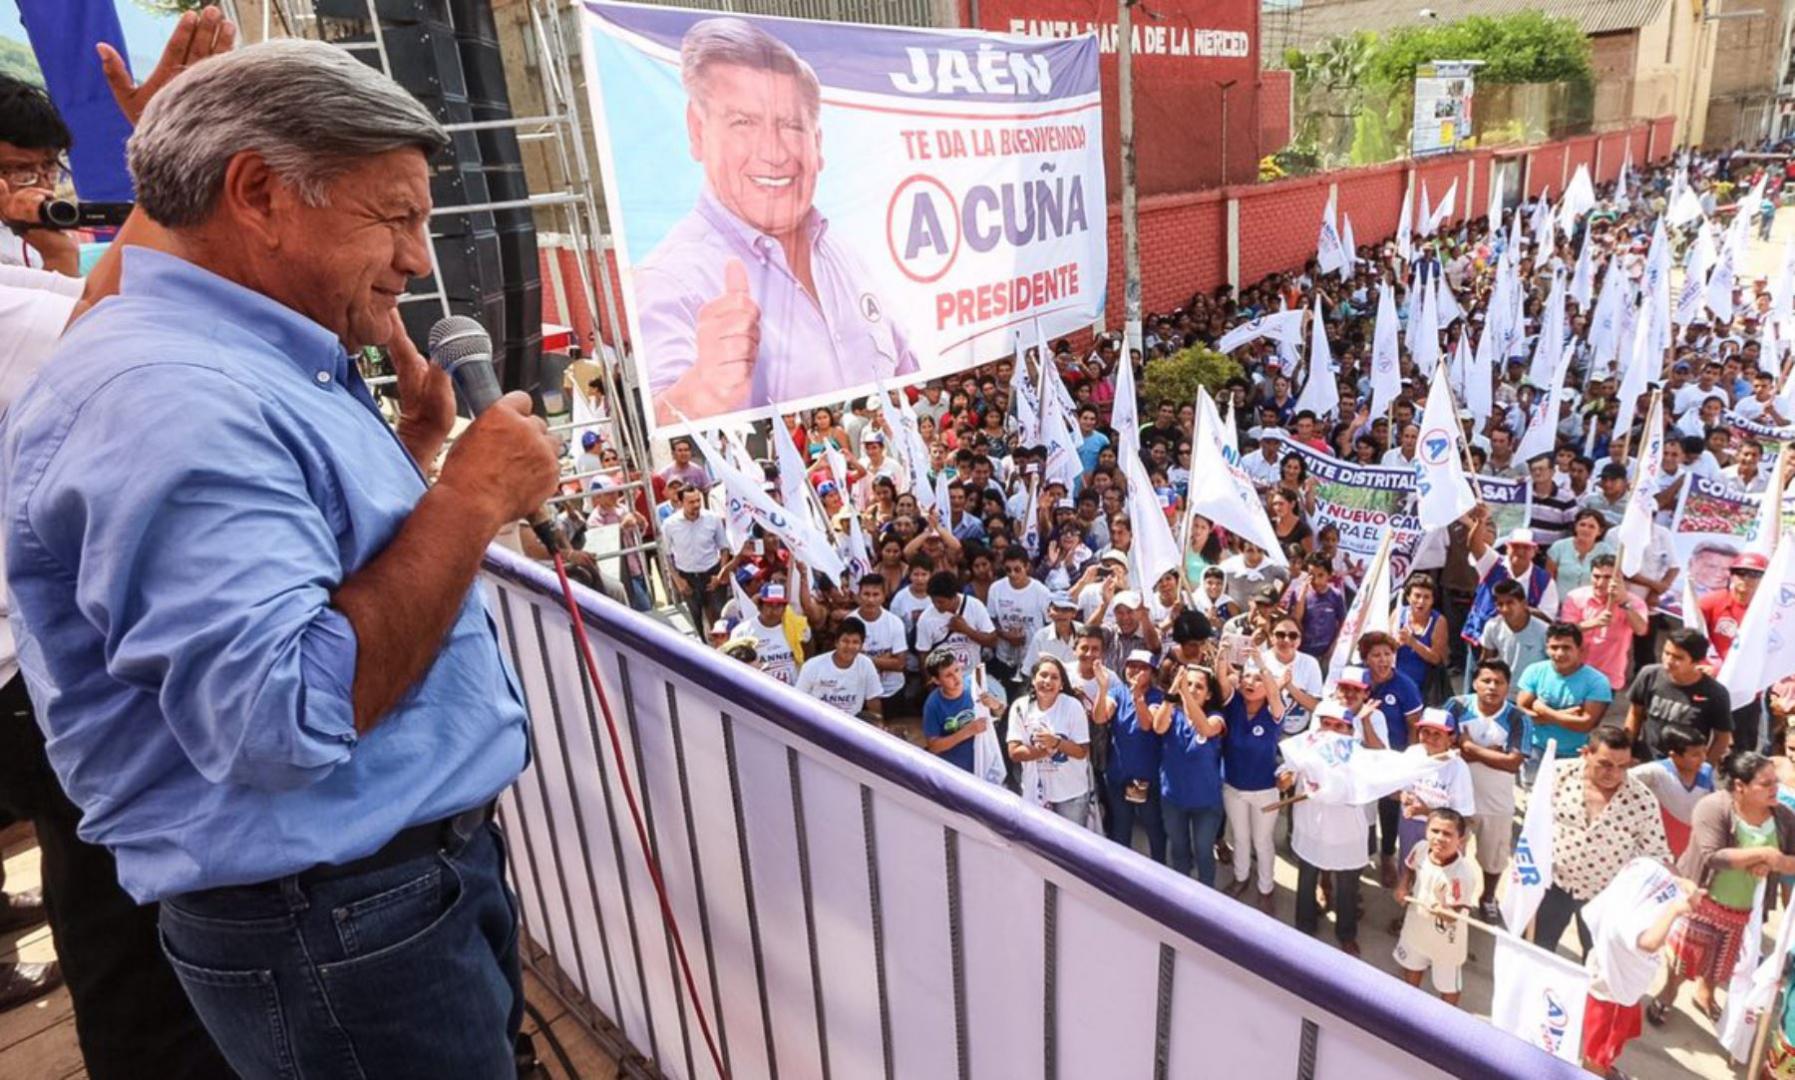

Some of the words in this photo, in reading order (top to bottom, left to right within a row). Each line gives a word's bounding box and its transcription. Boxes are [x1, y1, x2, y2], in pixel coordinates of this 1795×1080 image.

[1145, 26, 1166, 54] DE
[1170, 27, 1190, 56] LA
[1194, 29, 1249, 57] MERCED
[888, 43, 1052, 95] JAÉN
[900, 130, 931, 160] TE
[936, 130, 967, 158] DA
[971, 129, 996, 156] LA
[904, 162, 1088, 260] ACUÑA
[935, 262, 1079, 331] PRESIDENTE
[1339, 470, 1416, 489] DISTRITAL
[1317, 515, 1360, 539] PARA
[1363, 527, 1379, 541] EL
[1327, 504, 1386, 525] NUEVO
